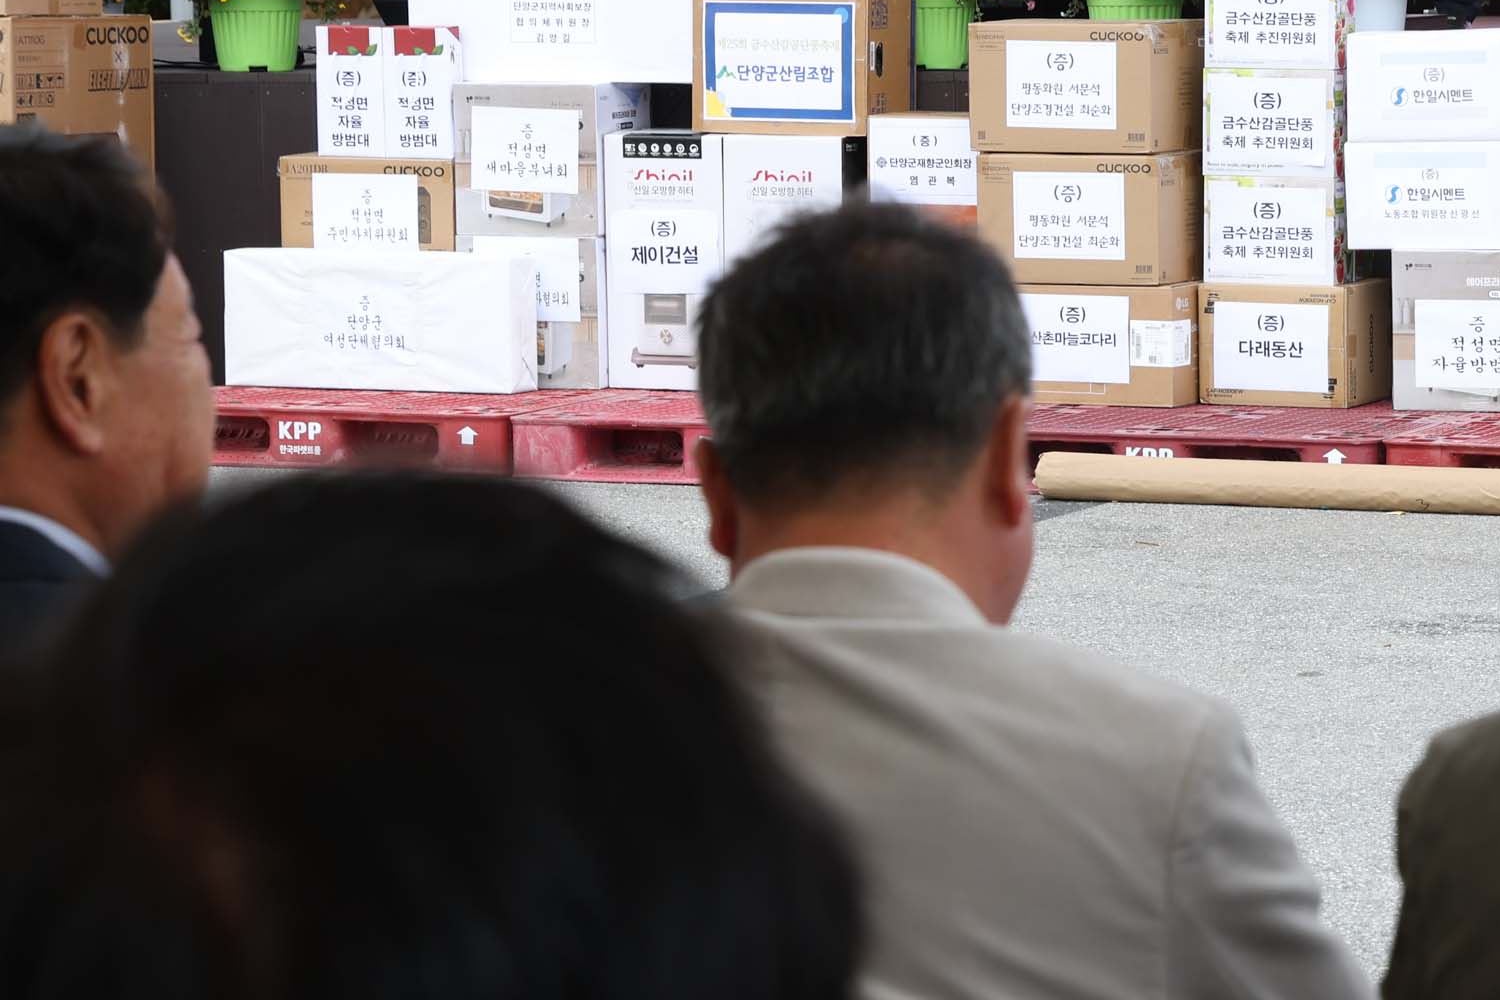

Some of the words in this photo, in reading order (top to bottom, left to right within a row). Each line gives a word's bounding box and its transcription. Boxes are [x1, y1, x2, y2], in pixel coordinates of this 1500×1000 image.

[1226, 11, 1316, 27] 금수산감골단풍
[86, 26, 150, 45] CUCKOO
[1090, 32, 1144, 41] CUCKOO
[1226, 31, 1249, 44] 축제
[1256, 32, 1316, 45] 추진위원회
[1046, 53, 1074, 71] (증)
[336, 70, 361, 87] (증)
[402, 70, 427, 87] (증)
[737, 65, 834, 83] 단양군산림조합
[1423, 67, 1445, 83] (증)
[1253, 92, 1282, 110] (증)
[1413, 89, 1474, 104] 한일시멘트
[338, 115, 362, 129] 자율
[405, 115, 430, 129] 자율
[1222, 116, 1313, 131] 금수산감골단풍
[522, 123, 533, 139] 증
[332, 133, 370, 148] 방범대
[400, 133, 438, 148] 방범대
[1222, 136, 1245, 149] 축제
[1253, 137, 1313, 150] 추진위원회
[383, 166, 445, 177] CUCKOO
[890, 158, 972, 169] 단양군재향군인회장
[1097, 164, 1150, 174] CUCKOO
[1054, 185, 1082, 203] (증)
[1407, 188, 1465, 201] 한일시멘트
[1253, 202, 1281, 219] (증)
[651, 221, 677, 237] (증)
[1222, 226, 1313, 241] 금수산감골단풍
[632, 246, 699, 264] 제이건설
[1223, 245, 1246, 258] 축제
[1253, 246, 1313, 259] 추진위원회
[359, 296, 370, 311] 증
[347, 315, 381, 330] 단양군
[1060, 307, 1086, 324] (증)
[1257, 314, 1285, 331] (증)
[1469, 316, 1485, 333] 증
[1239, 340, 1303, 358] 다래동산
[278, 421, 322, 440] KPP
